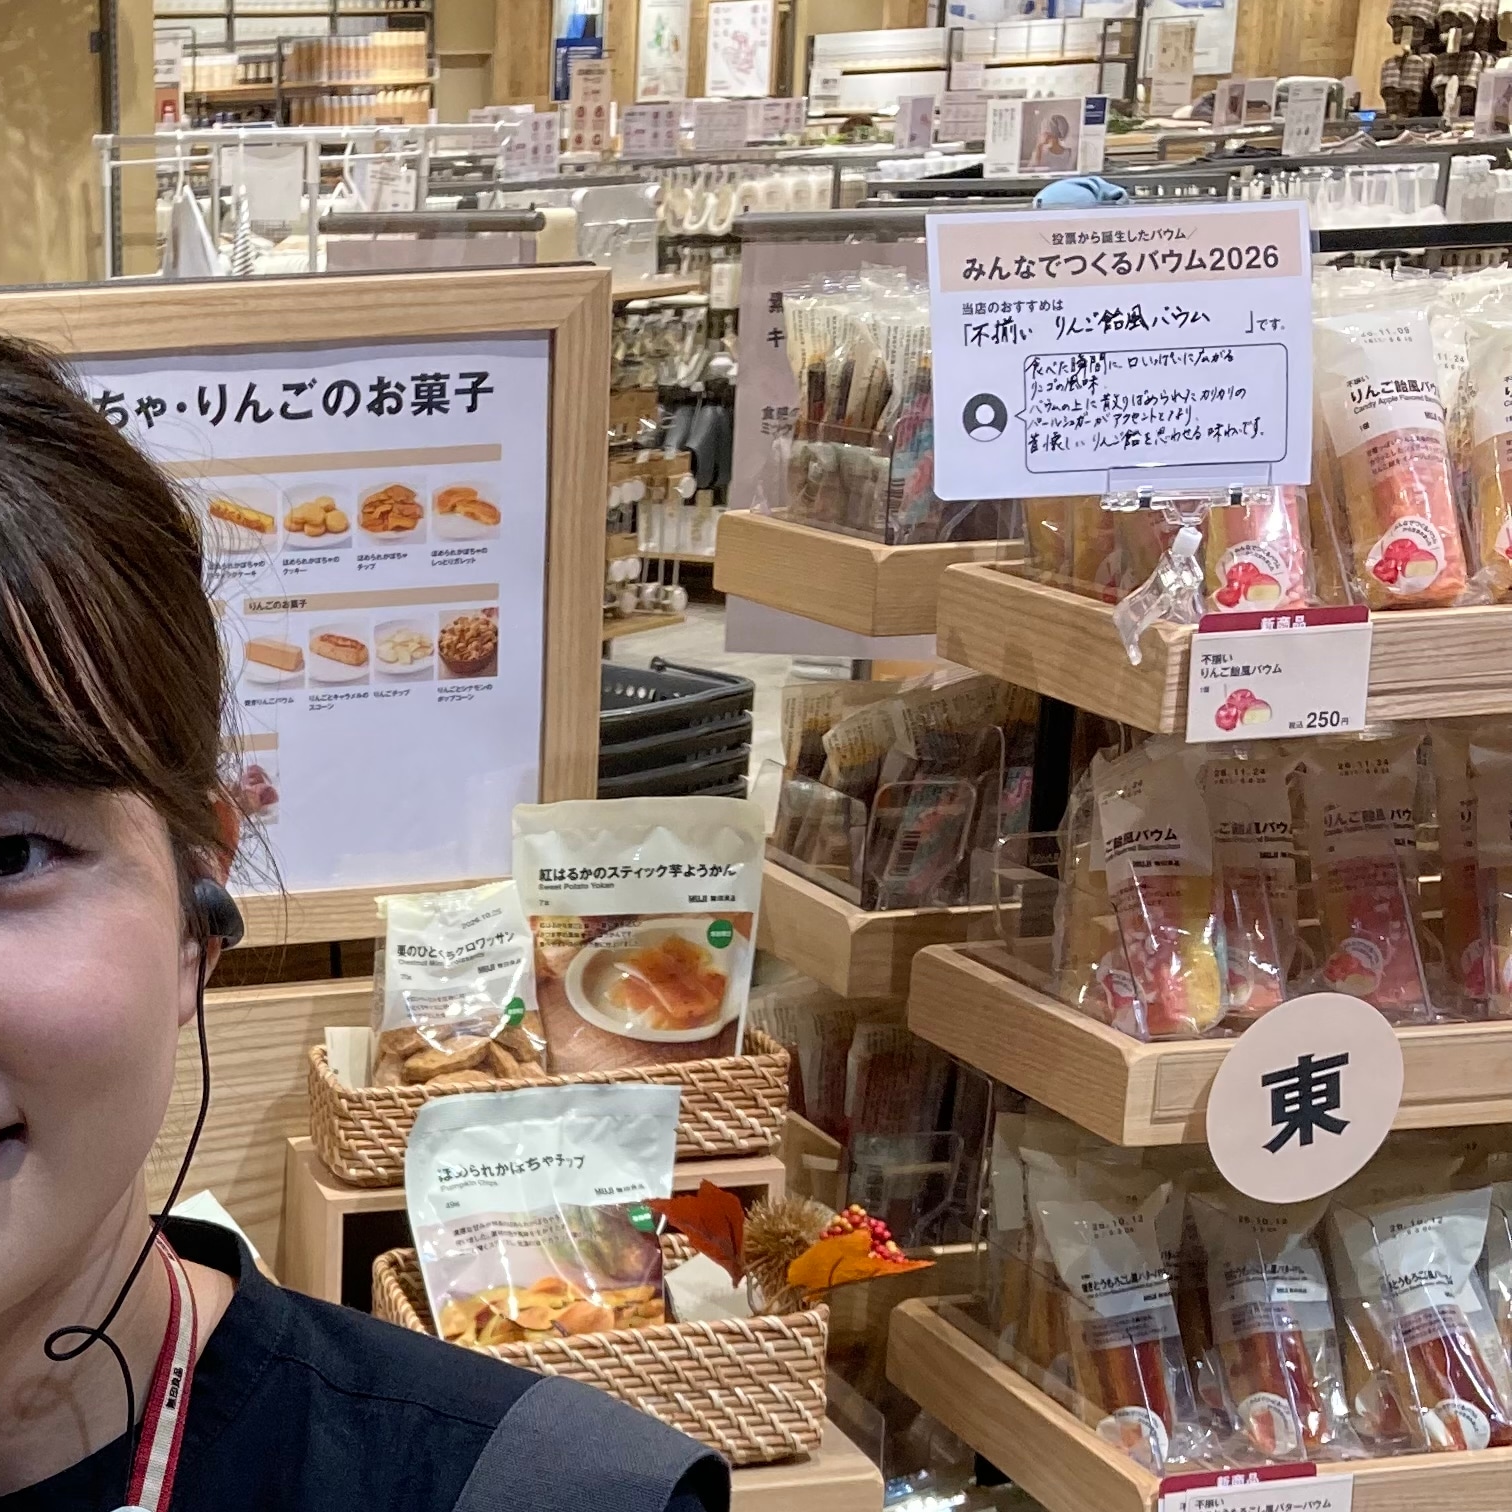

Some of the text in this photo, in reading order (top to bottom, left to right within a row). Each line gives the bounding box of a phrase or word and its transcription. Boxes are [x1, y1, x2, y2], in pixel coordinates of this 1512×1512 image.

[1051, 228, 1187, 246] 投票から誕生したバウム
[962, 244, 1280, 281] みんなでつくるバウム2026
[961, 298, 1063, 316] 当店のおすすめは
[1054, 304, 1210, 340] りんご飴風バウム
[248, 599, 308, 610] りんごのお菓子
[1200, 664, 1282, 678] りんご飴風バウム
[374, 688, 410, 698] りんごチップ
[1306, 711, 1349, 729] 250円
[539, 864, 737, 882] 紅はるかのスティック芋ようかん
[1261, 1052, 1351, 1155] 東
